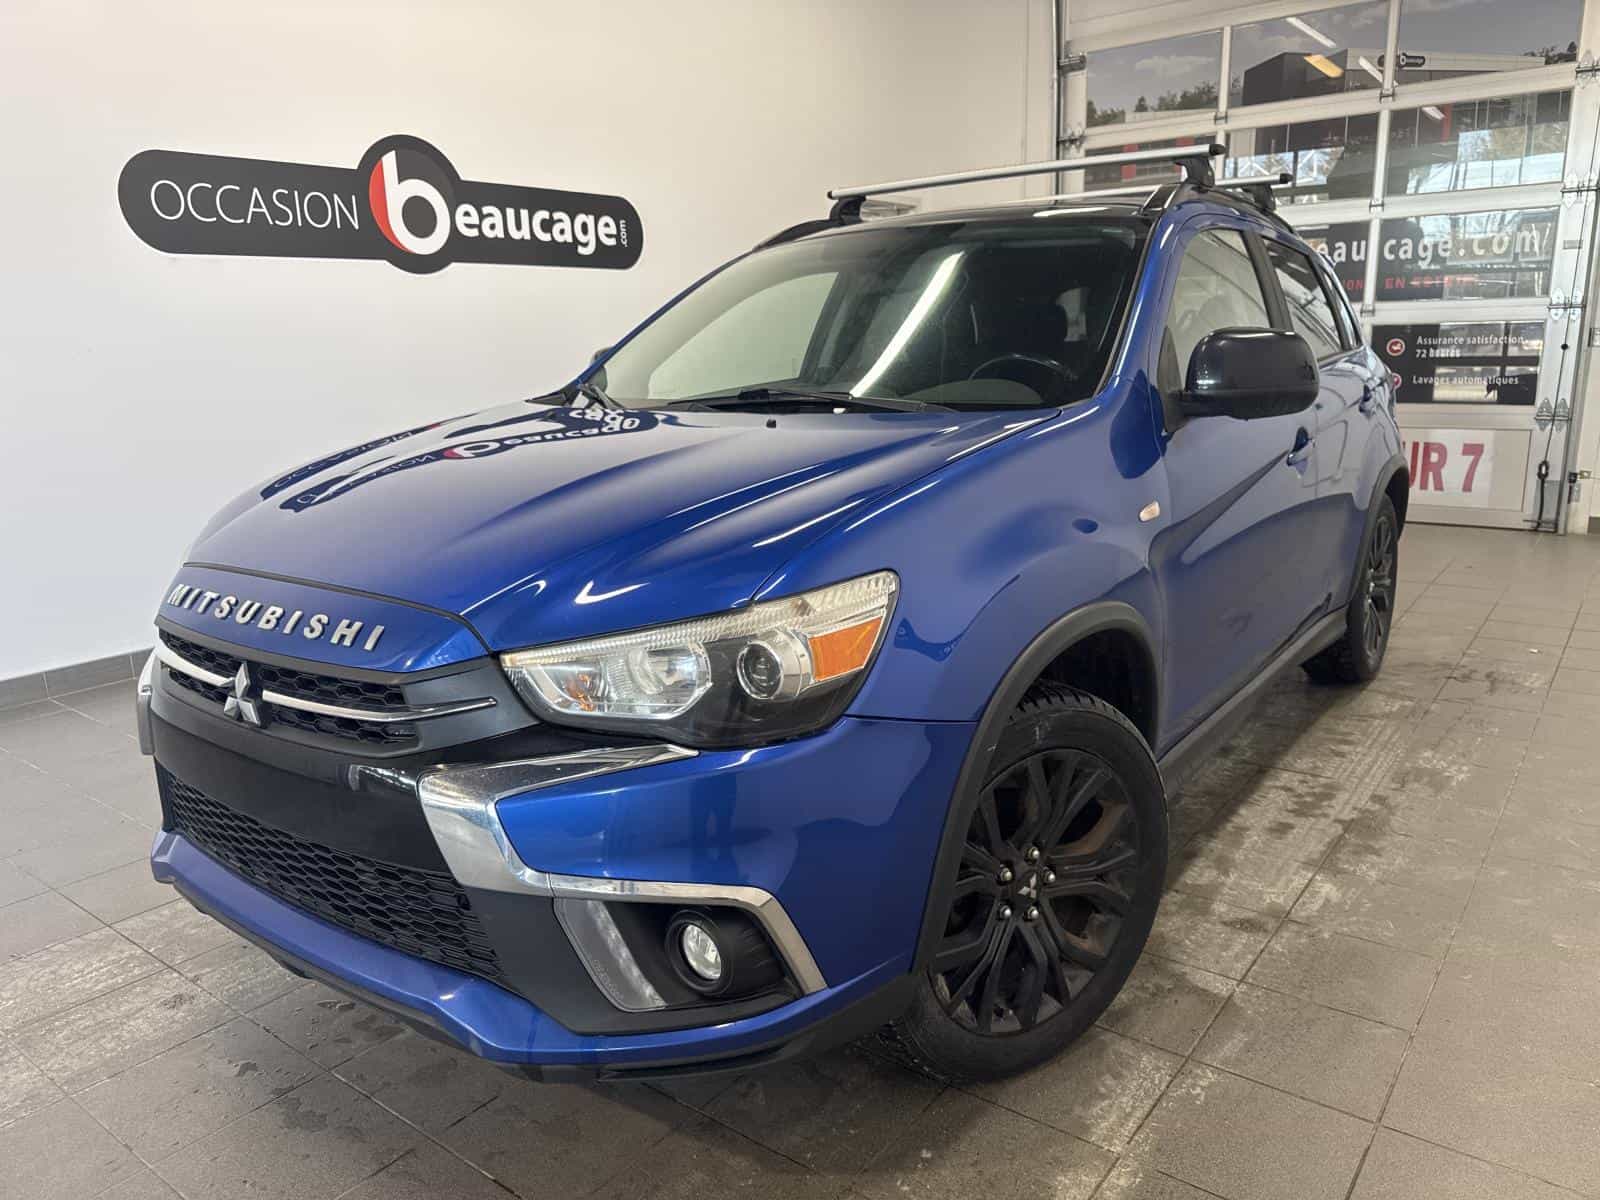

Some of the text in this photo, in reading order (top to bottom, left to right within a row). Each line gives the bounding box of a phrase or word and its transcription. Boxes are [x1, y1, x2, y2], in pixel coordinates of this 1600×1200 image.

[150, 179, 360, 231] OCCASION
[1416, 335, 1465, 345] Assurance
[1416, 349, 1427, 358] 72
[1453, 374, 1519, 386] automatiques
[1462, 443, 1485, 492] 7
[167, 583, 385, 652] MITSUBISHI
